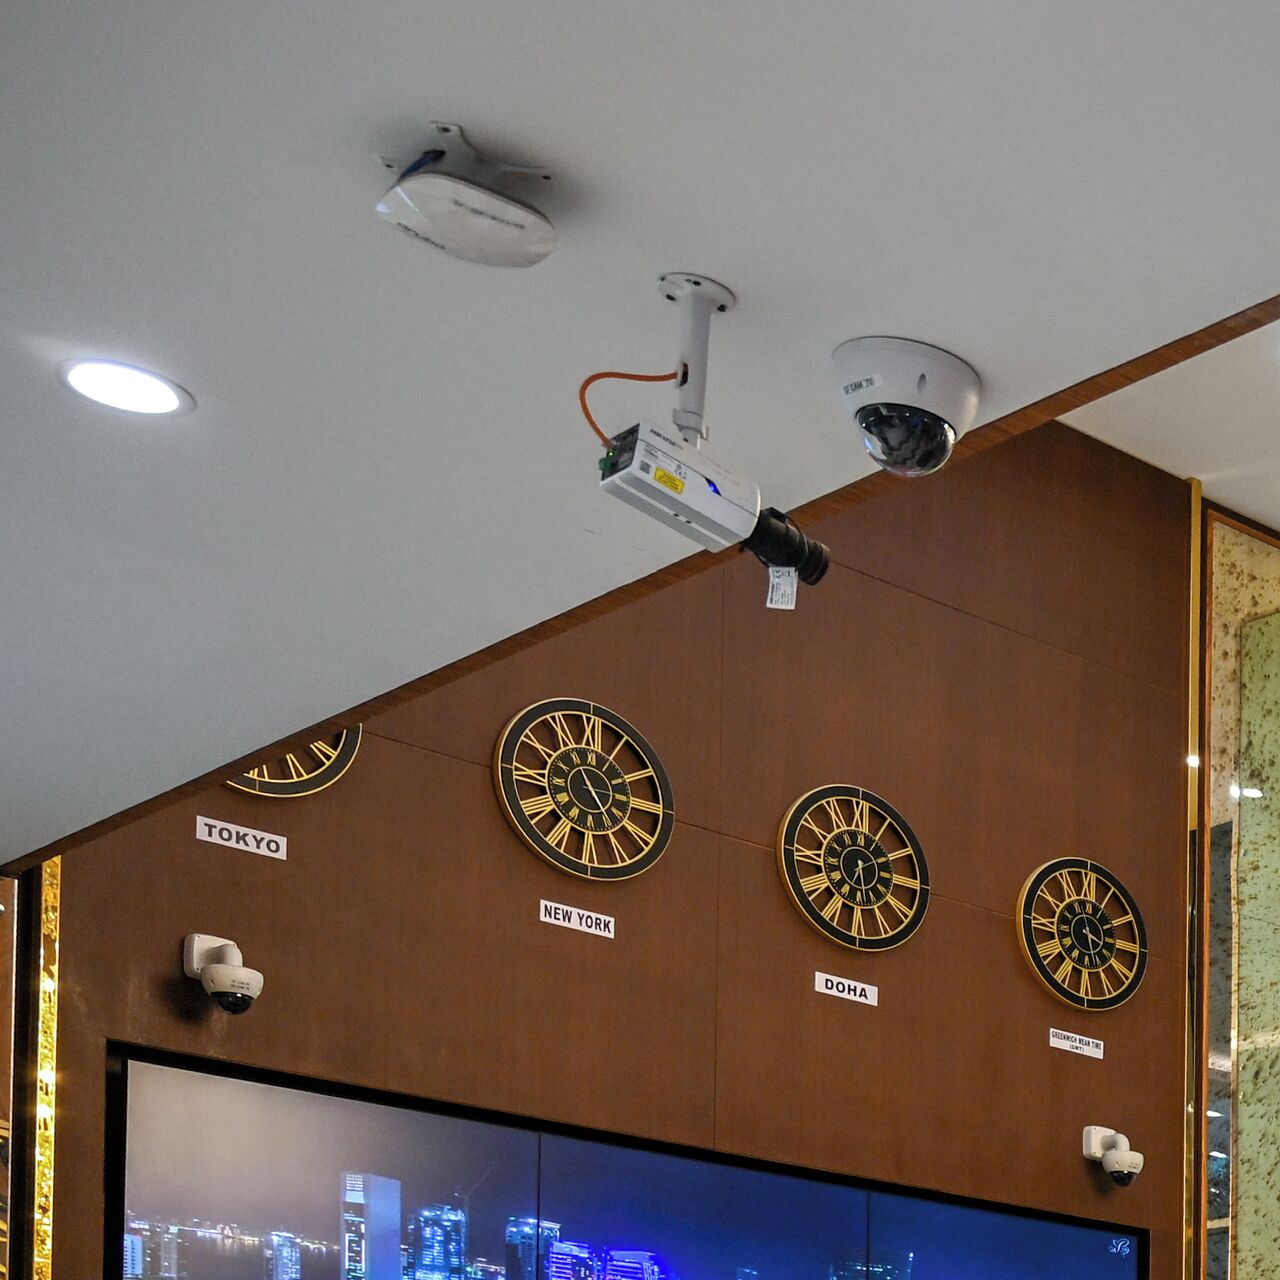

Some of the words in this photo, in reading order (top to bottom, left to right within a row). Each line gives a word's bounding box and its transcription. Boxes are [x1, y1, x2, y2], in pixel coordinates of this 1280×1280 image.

[204, 823, 280, 853] TOKYO
[544, 904, 572, 923] NEW
[577, 912, 611, 933] YORK
[825, 978, 868, 1000] DOHA
[1052, 1031, 1077, 1043] GREENWICH
